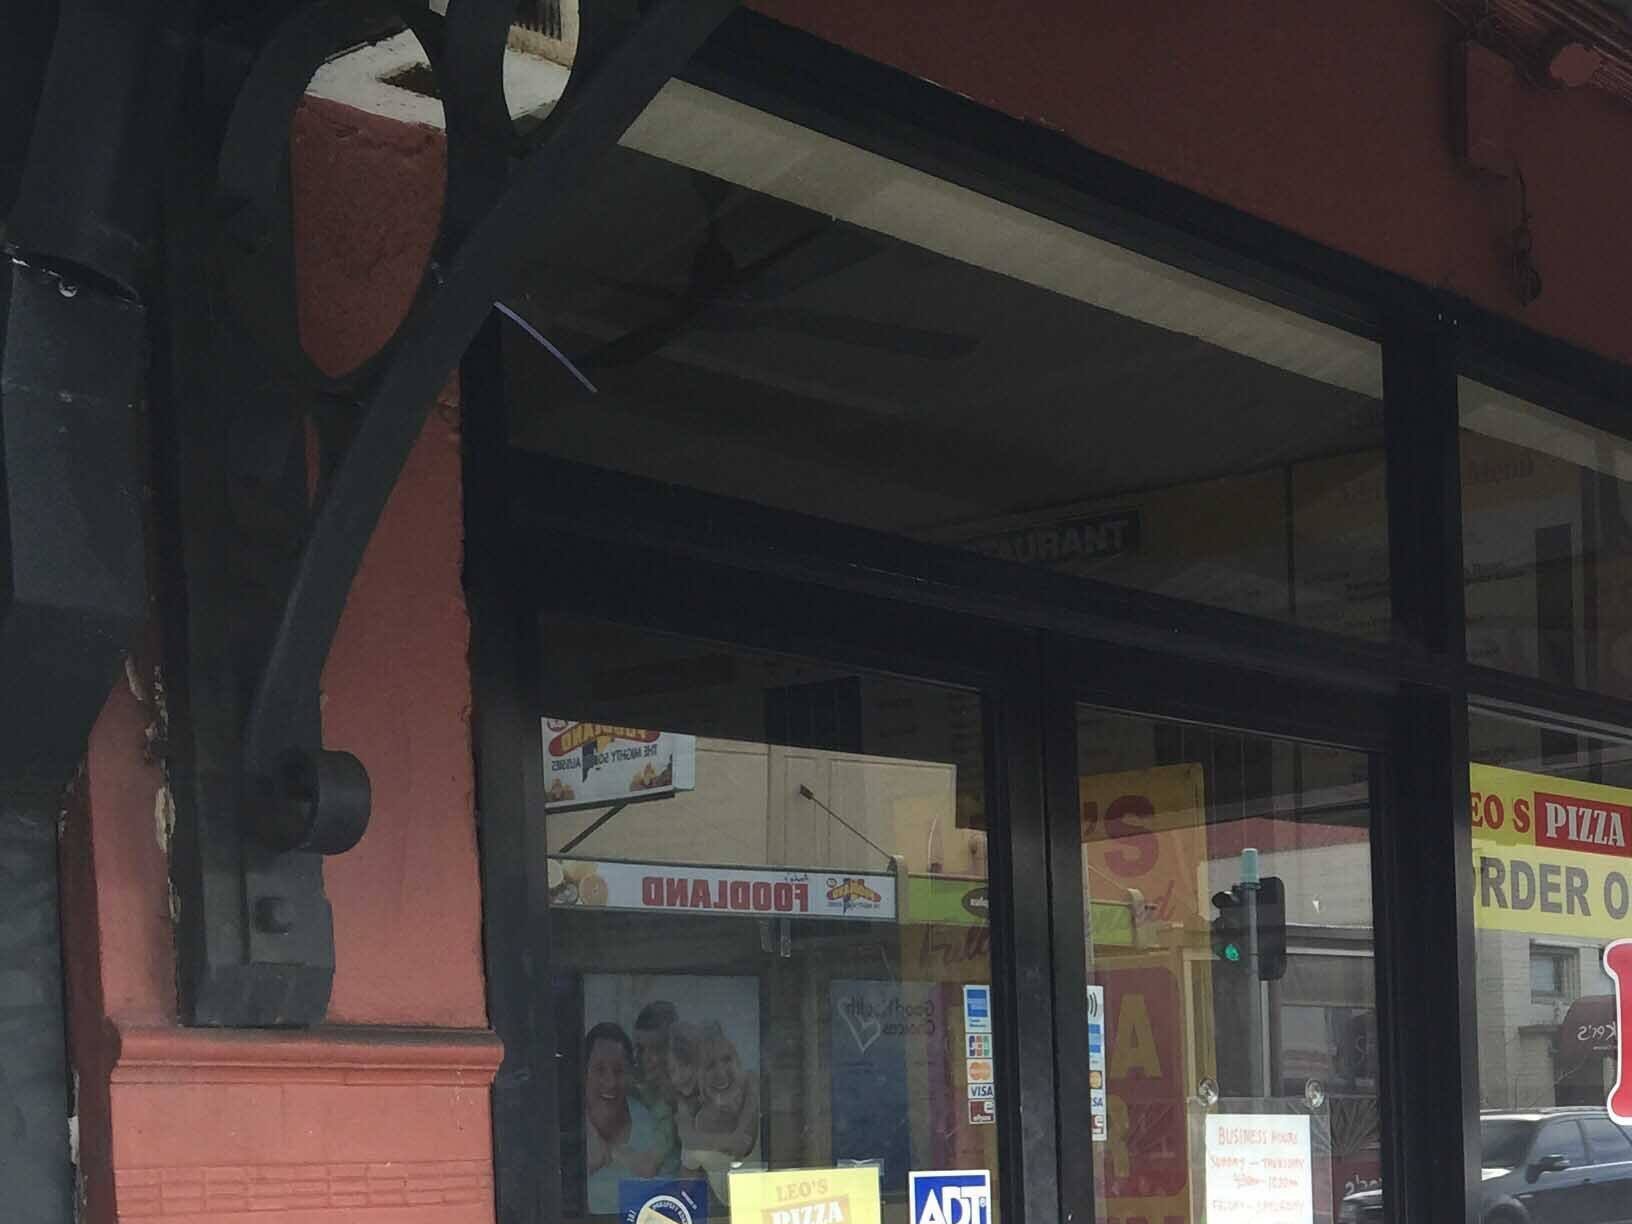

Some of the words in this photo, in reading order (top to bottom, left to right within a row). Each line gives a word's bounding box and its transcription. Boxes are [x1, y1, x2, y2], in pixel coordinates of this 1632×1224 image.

[1545, 802, 1625, 847] PIZZA
[1474, 856, 1592, 916] RDER
[971, 1086, 993, 1097] VISA
[776, 1178, 828, 1201] LEO'S
